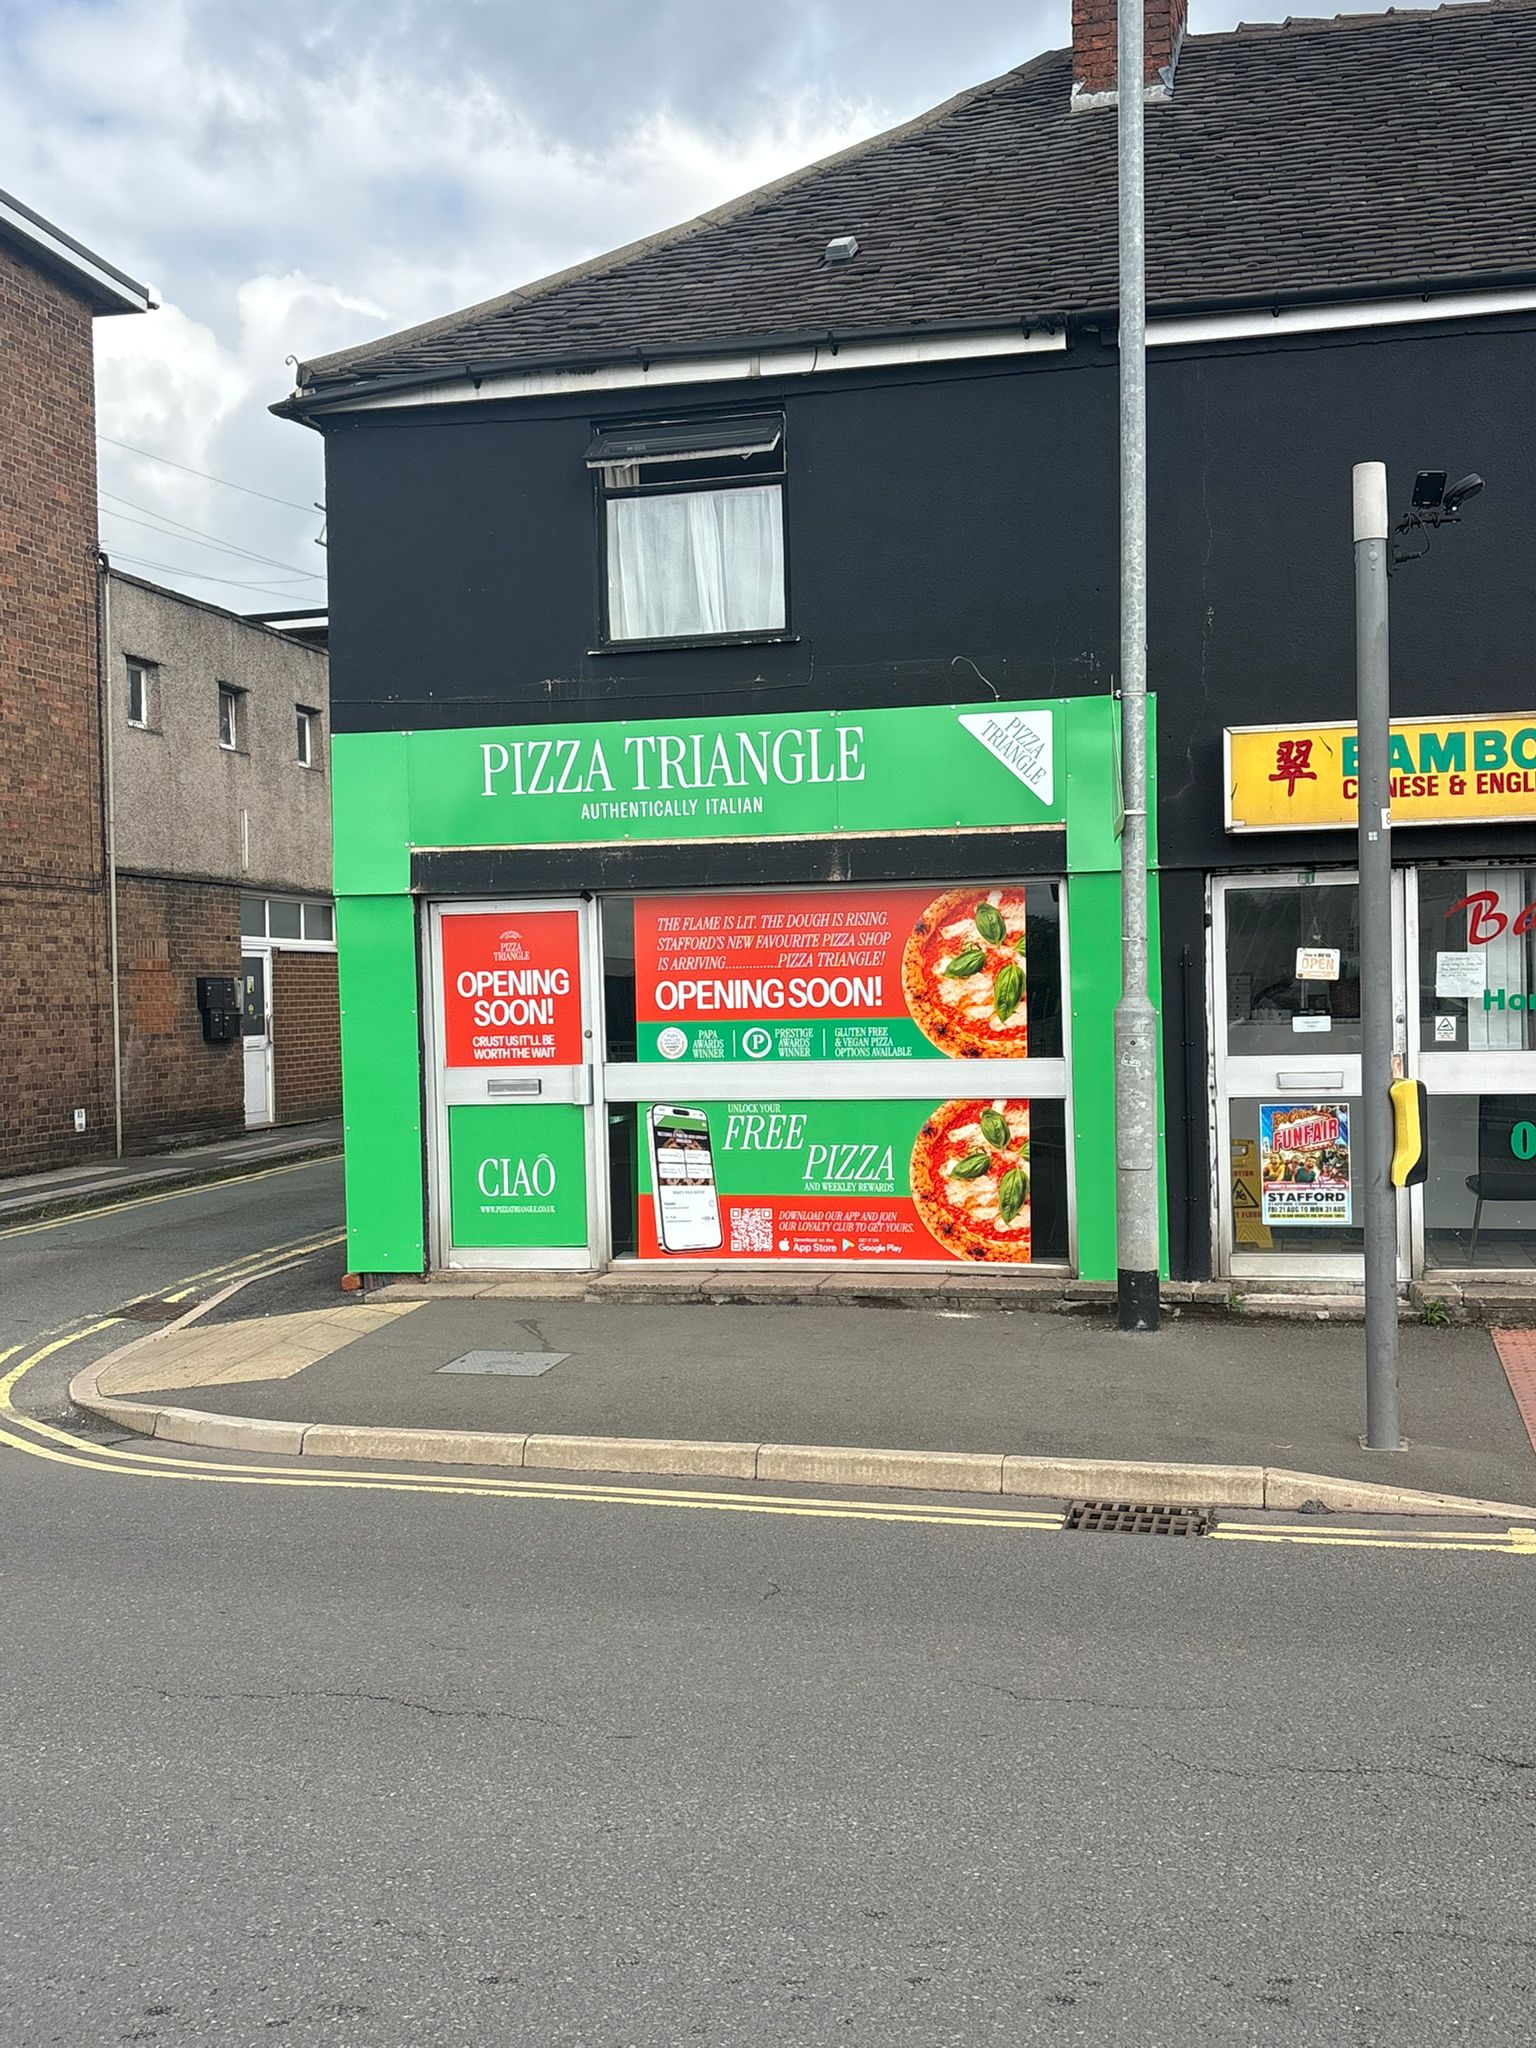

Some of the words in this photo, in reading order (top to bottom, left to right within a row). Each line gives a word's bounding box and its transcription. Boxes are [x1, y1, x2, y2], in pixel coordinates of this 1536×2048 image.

[1005, 716, 1045, 760] PIZZA
[981, 719, 1047, 785] TRIANGLE
[480, 739, 616, 796] PIZZA
[625, 726, 865, 790] TRIANGLE
[1342, 775, 1439, 799] CNESE
[1449, 774, 1467, 795] &
[1476, 771, 1536, 795] ENGL
[581, 799, 698, 819] AUTHENTICALLY
[706, 796, 763, 815] ITALIAN
[657, 917, 680, 931] THE
[682, 916, 721, 931] FLAME
[722, 915, 735, 930] IS
[736, 915, 757, 930] LIT.
[761, 914, 785, 929] THE
[786, 912, 830, 928] DOUGH
[831, 912, 844, 927] IS
[845, 911, 889, 927] RISING.
[500, 942, 522, 952] PIZZA
[657, 936, 725, 951] STAFFORD'S
[726, 935, 755, 949] NEW
[755, 933, 820, 949] FAVOURITE
[822, 932, 855, 947] PIZZA
[857, 931, 892, 946] SHOP
[493, 951, 531, 961] TRIANGLE
[657, 956, 669, 971] IS
[778, 952, 813, 968] PIZZA
[817, 951, 886, 967] TRIANGLE!
[1301, 957, 1334, 970] OPEN
[457, 968, 570, 998] OPENING
[655, 978, 784, 1010] OPENING
[788, 976, 882, 1008] SOON!
[474, 998, 554, 1026] SOON!
[698, 1029, 718, 1039] PAPA
[775, 1028, 814, 1038] PRESTIGE
[834, 1027, 866, 1037] GLUTEN
[868, 1027, 888, 1036] FREE
[472, 1035, 504, 1047] CRUST
[505, 1035, 519, 1046] US
[519, 1034, 541, 1046] IT'LL
[542, 1034, 555, 1045] BE
[692, 1039, 724, 1049] AWARDS
[778, 1038, 811, 1048] AWARDS
[835, 1037, 842, 1047] &
[842, 1037, 870, 1047] VEGAN
[870, 1037, 893, 1047] PIZZA
[473, 1048, 510, 1060] WORTH
[511, 1047, 530, 1058] THE
[531, 1047, 556, 1058] WAIT
[692, 1049, 725, 1058] WINNER
[778, 1047, 811, 1057] WINNER
[834, 1047, 870, 1057] OPTIONS
[871, 1047, 912, 1057] AVAILABLE
[728, 1104, 758, 1113] UNLOCK
[759, 1104, 781, 1113] YOUR
[721, 1114, 808, 1150] FREE
[1272, 1117, 1339, 1153] FUNFAIR
[802, 1144, 895, 1181] PIZZA
[804, 1182, 821, 1191] AND
[858, 1182, 895, 1193] REWARDS
[1268, 1192, 1345, 1202] STAFFORD
[779, 1210, 824, 1220] DOWNLOAD
[824, 1211, 844, 1221] OUR
[844, 1211, 861, 1221] APP
[861, 1211, 879, 1221] AND
[878, 1212, 898, 1222] JOIN
[779, 1221, 797, 1231] OUR
[797, 1221, 832, 1231] LOYALTY
[832, 1222, 855, 1232] CLUB
[855, 1222, 867, 1232] TO
[867, 1223, 885, 1232] GET
[885, 1223, 915, 1233] YOURS.
[793, 1243, 812, 1252] App
[812, 1243, 838, 1252] Store
[858, 1243, 886, 1253] Google
[887, 1243, 903, 1254] Play
